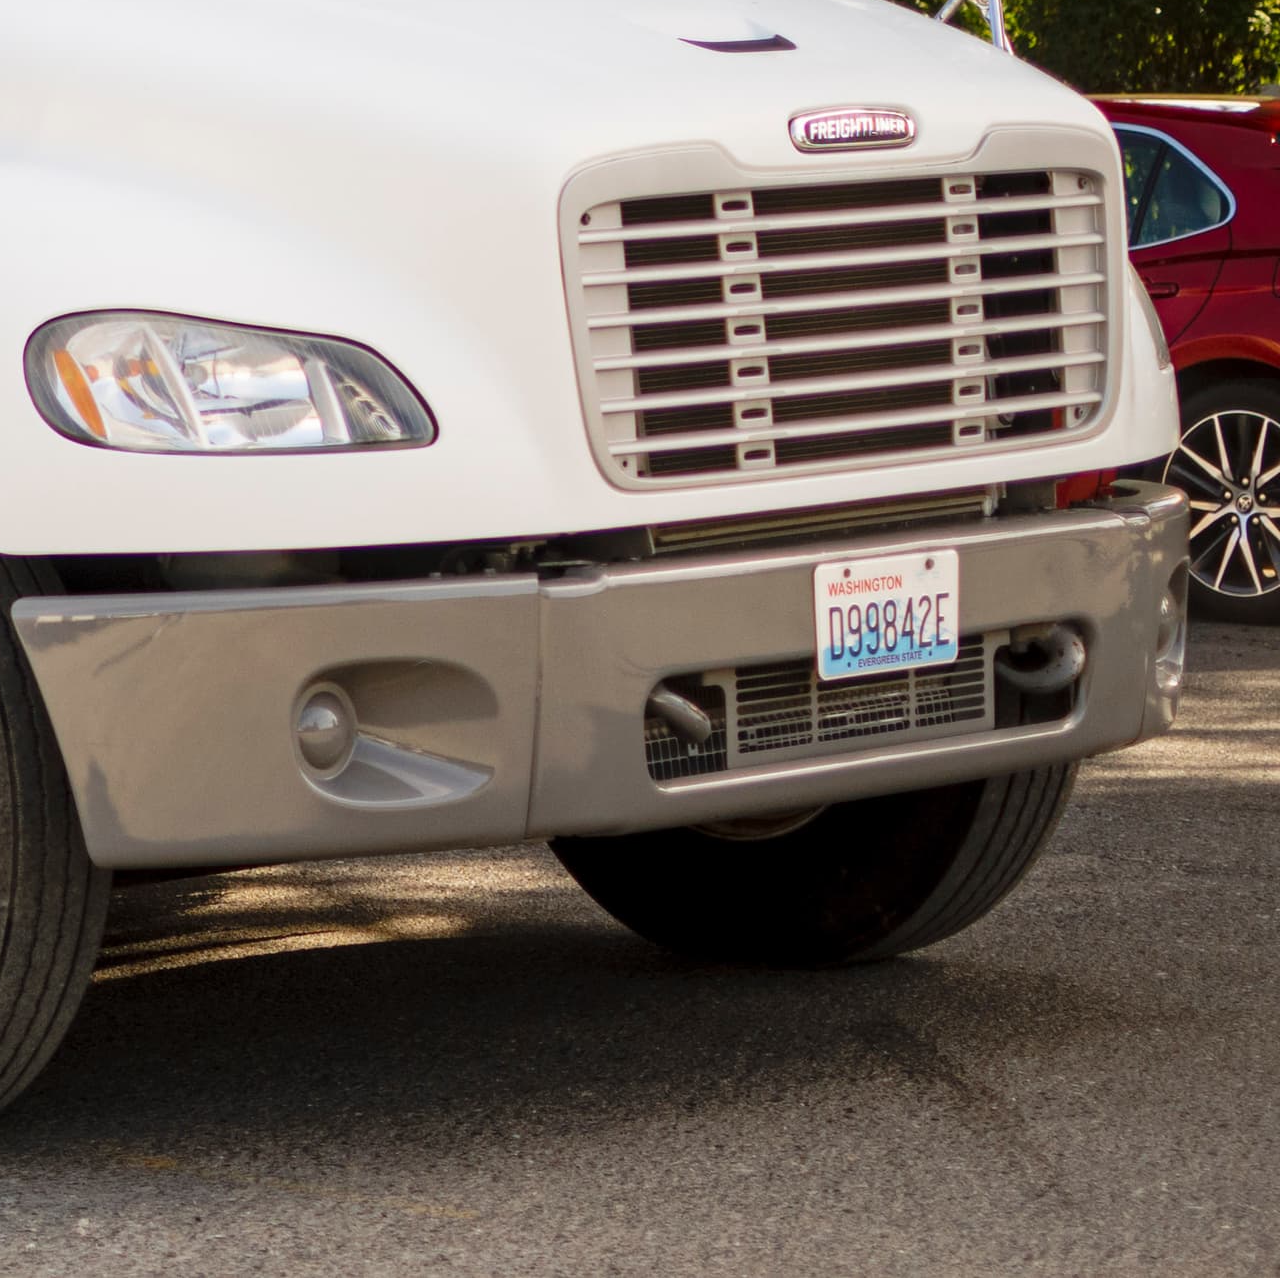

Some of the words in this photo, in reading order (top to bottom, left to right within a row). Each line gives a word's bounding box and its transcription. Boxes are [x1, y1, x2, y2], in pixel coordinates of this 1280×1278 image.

[810, 118, 905, 139] FREIGHTLINER
[828, 575, 903, 597] WASHINGTON
[829, 593, 950, 661] D99842E
[857, 653, 901, 668] EVERGREEN
[901, 650, 923, 662] STATE
